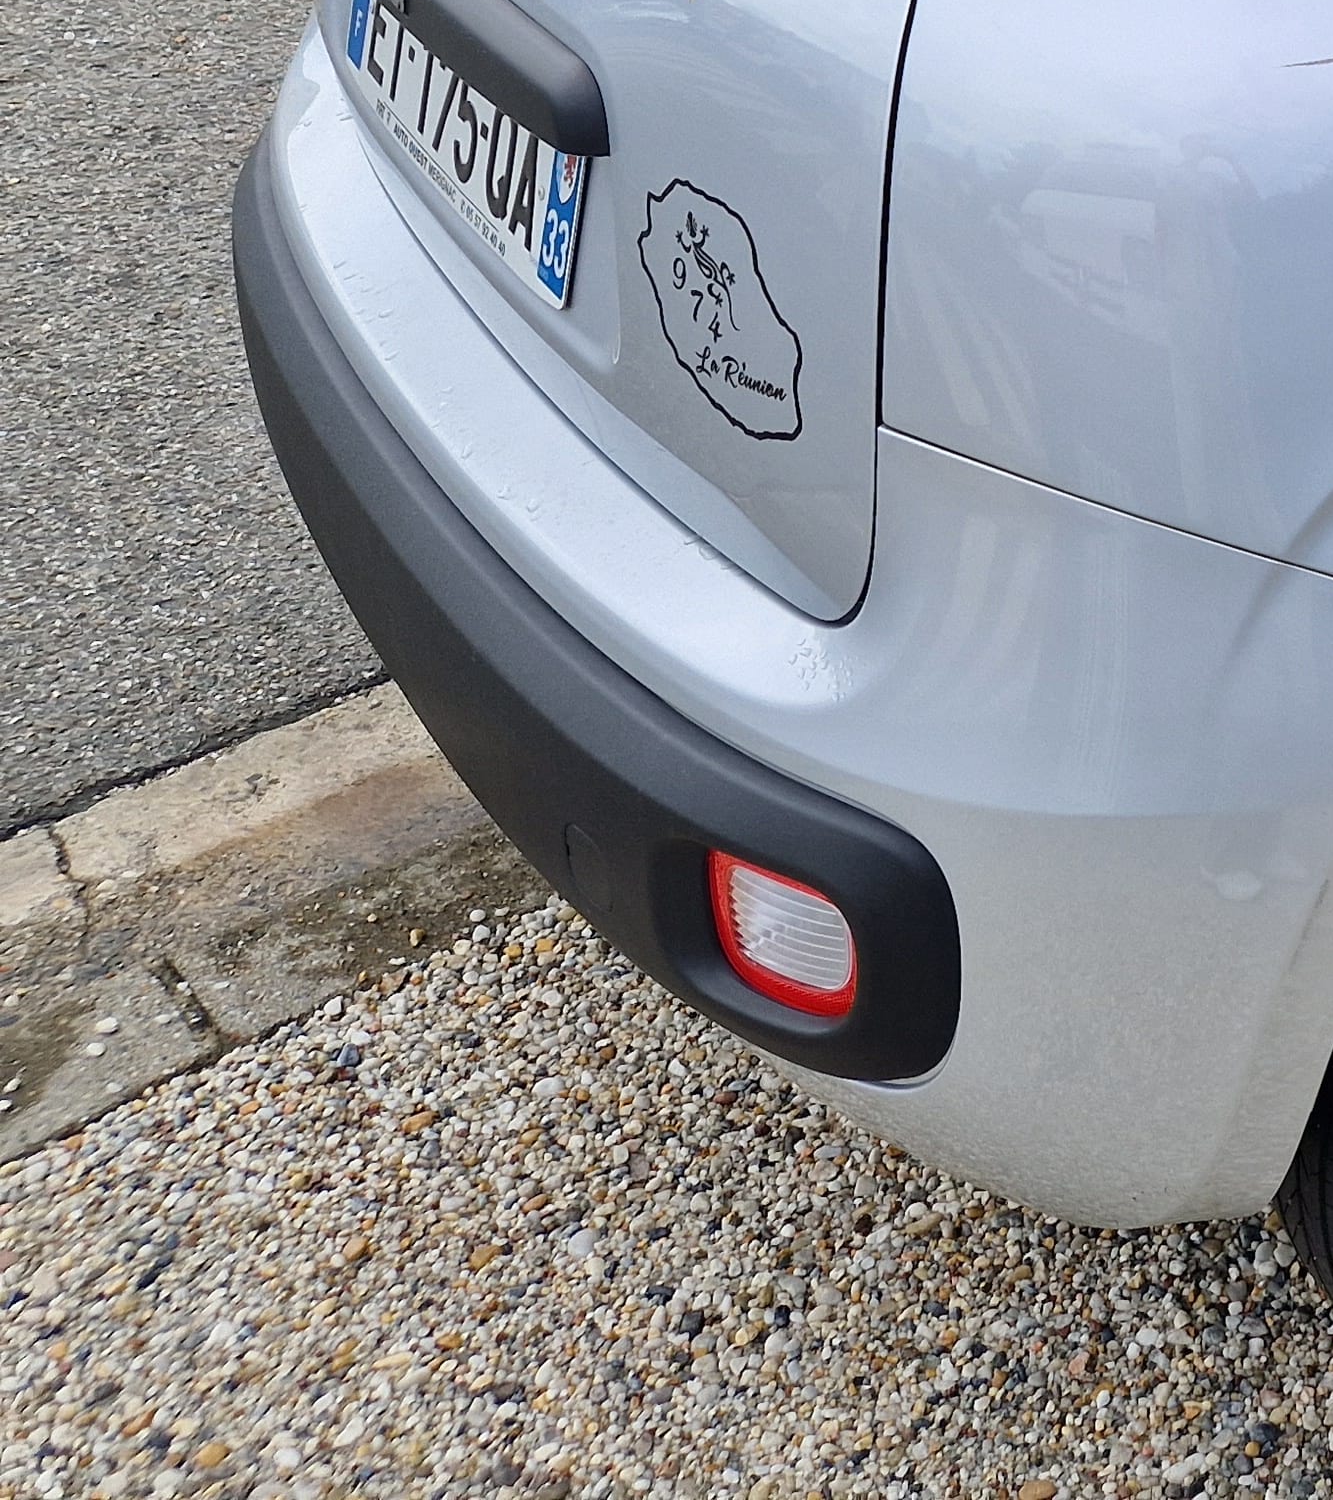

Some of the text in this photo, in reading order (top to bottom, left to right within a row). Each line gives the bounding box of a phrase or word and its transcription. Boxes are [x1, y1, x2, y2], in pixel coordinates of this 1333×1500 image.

[354, 8, 364, 37] F
[393, 123, 409, 149] AUTO
[409, 142, 428, 170] OUEST
[542, 208, 570, 279] 33
[696, 346, 788, 402] La Réunion
